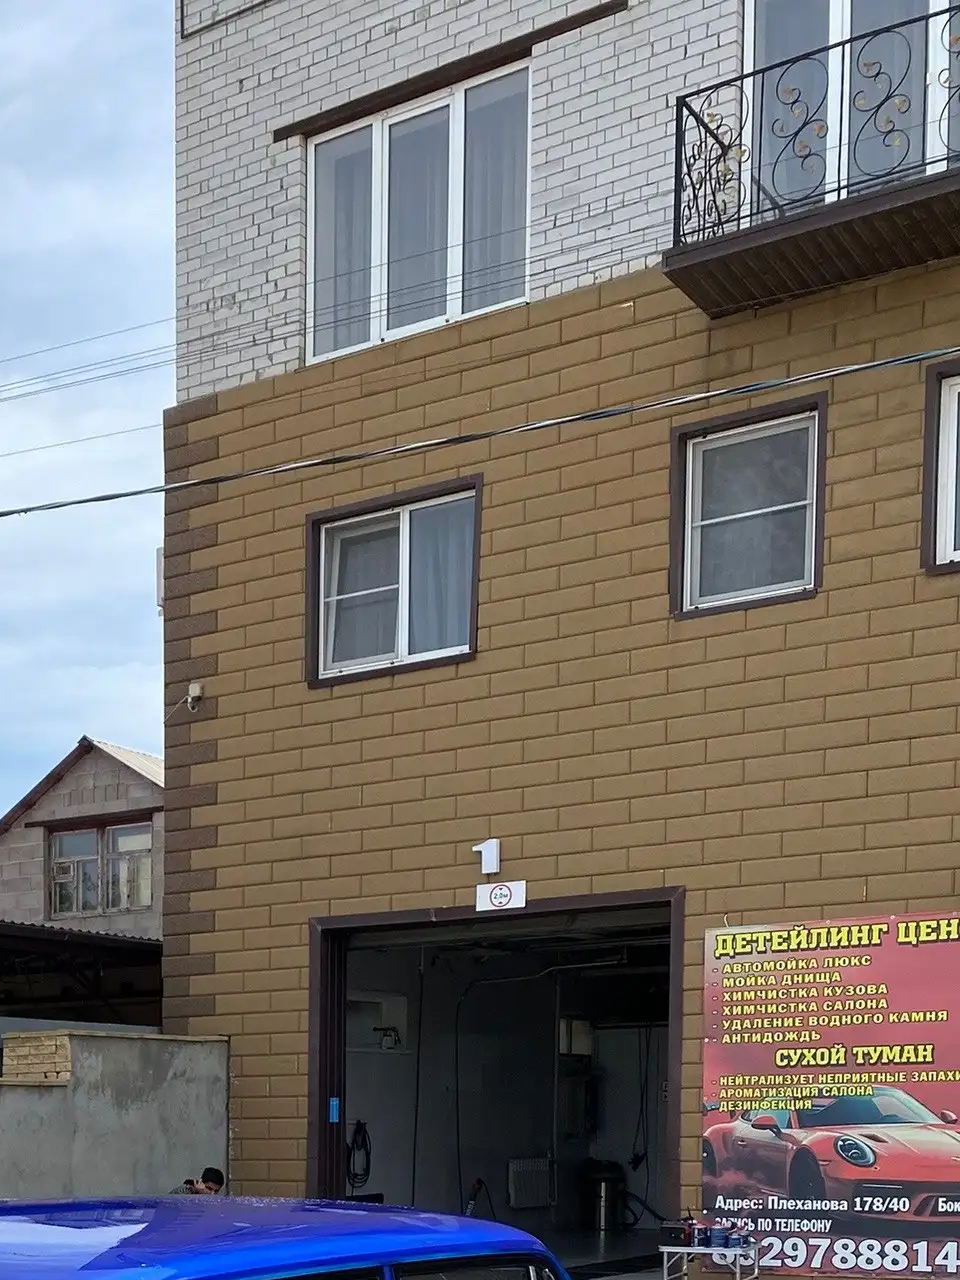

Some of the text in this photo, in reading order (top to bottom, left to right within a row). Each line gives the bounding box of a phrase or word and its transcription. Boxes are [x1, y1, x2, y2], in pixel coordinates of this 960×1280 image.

[715, 919, 959, 957] ДЕТЕЙЛИНГ ЦЕН
[722, 955, 872, 974] АВТОМОЙКА ЛЮКС
[722, 972, 841, 988] МОЙКА ДНИЩА
[722, 984, 888, 1002] ХИМЧИСТКА КУЗОВА
[722, 999, 888, 1016] ХИМЧИСТКА САЛОНА
[722, 1010, 949, 1031] УДАЛЕНИЕ ВОДНОГО КАМНЯ
[722, 1030, 821, 1044] АНТИДОЖДЬ
[775, 1044, 933, 1066] СУХОЙ ТУМАН
[720, 1073, 814, 1086] НЕЙТРАЛИЗУЕТ
[818, 1072, 907, 1083] НЕПРИЯТНЫЕ
[719, 1085, 874, 1098] АРОМАТИЗАЦИЯ САЛОНА
[719, 1100, 812, 1112] ДЕЗИНФЕКЦИЯ
[715, 1195, 763, 1211] Адрес:
[767, 1196, 848, 1211] Плеханова
[853, 1197, 910, 1212] 178/40
[757, 1218, 772, 1231] ПО
[775, 1218, 832, 1233] ТЕЛЕФОНУ
